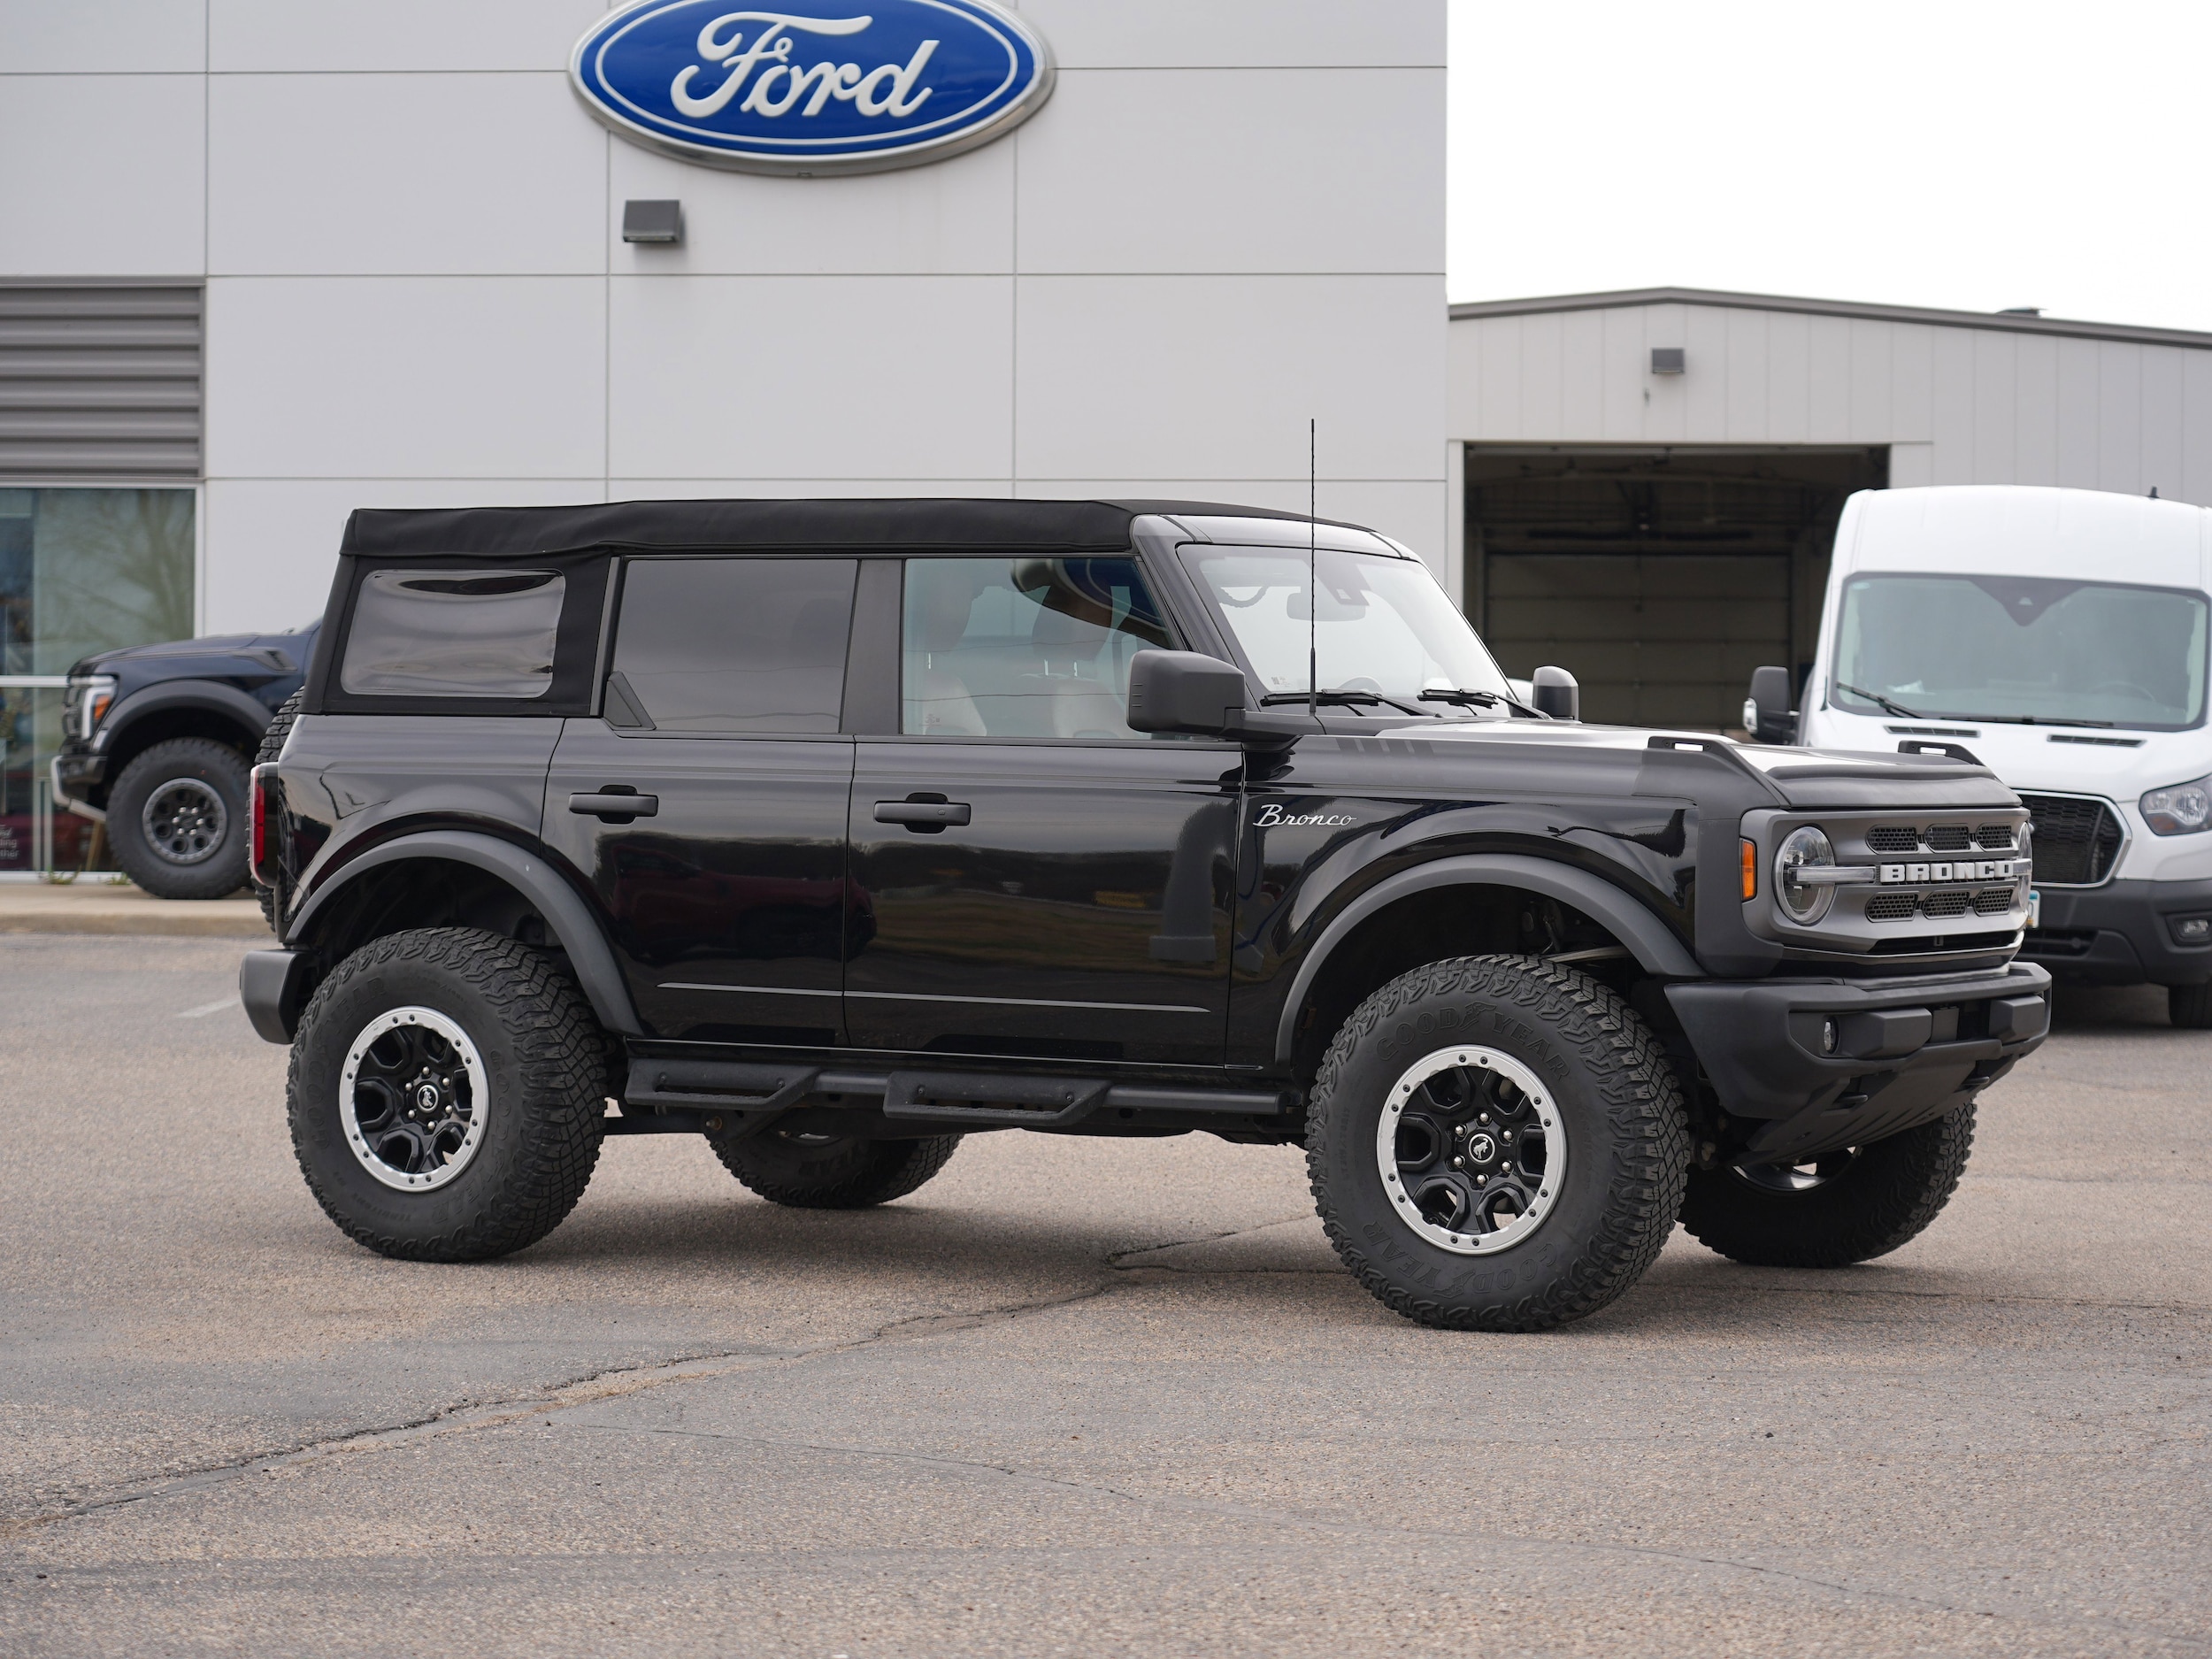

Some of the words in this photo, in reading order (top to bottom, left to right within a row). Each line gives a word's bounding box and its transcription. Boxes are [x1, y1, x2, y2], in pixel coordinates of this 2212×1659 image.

[671, 12, 940, 118] Ford
[1253, 803, 1357, 827] Bronco
[1880, 860, 2014, 883] BRONCO
